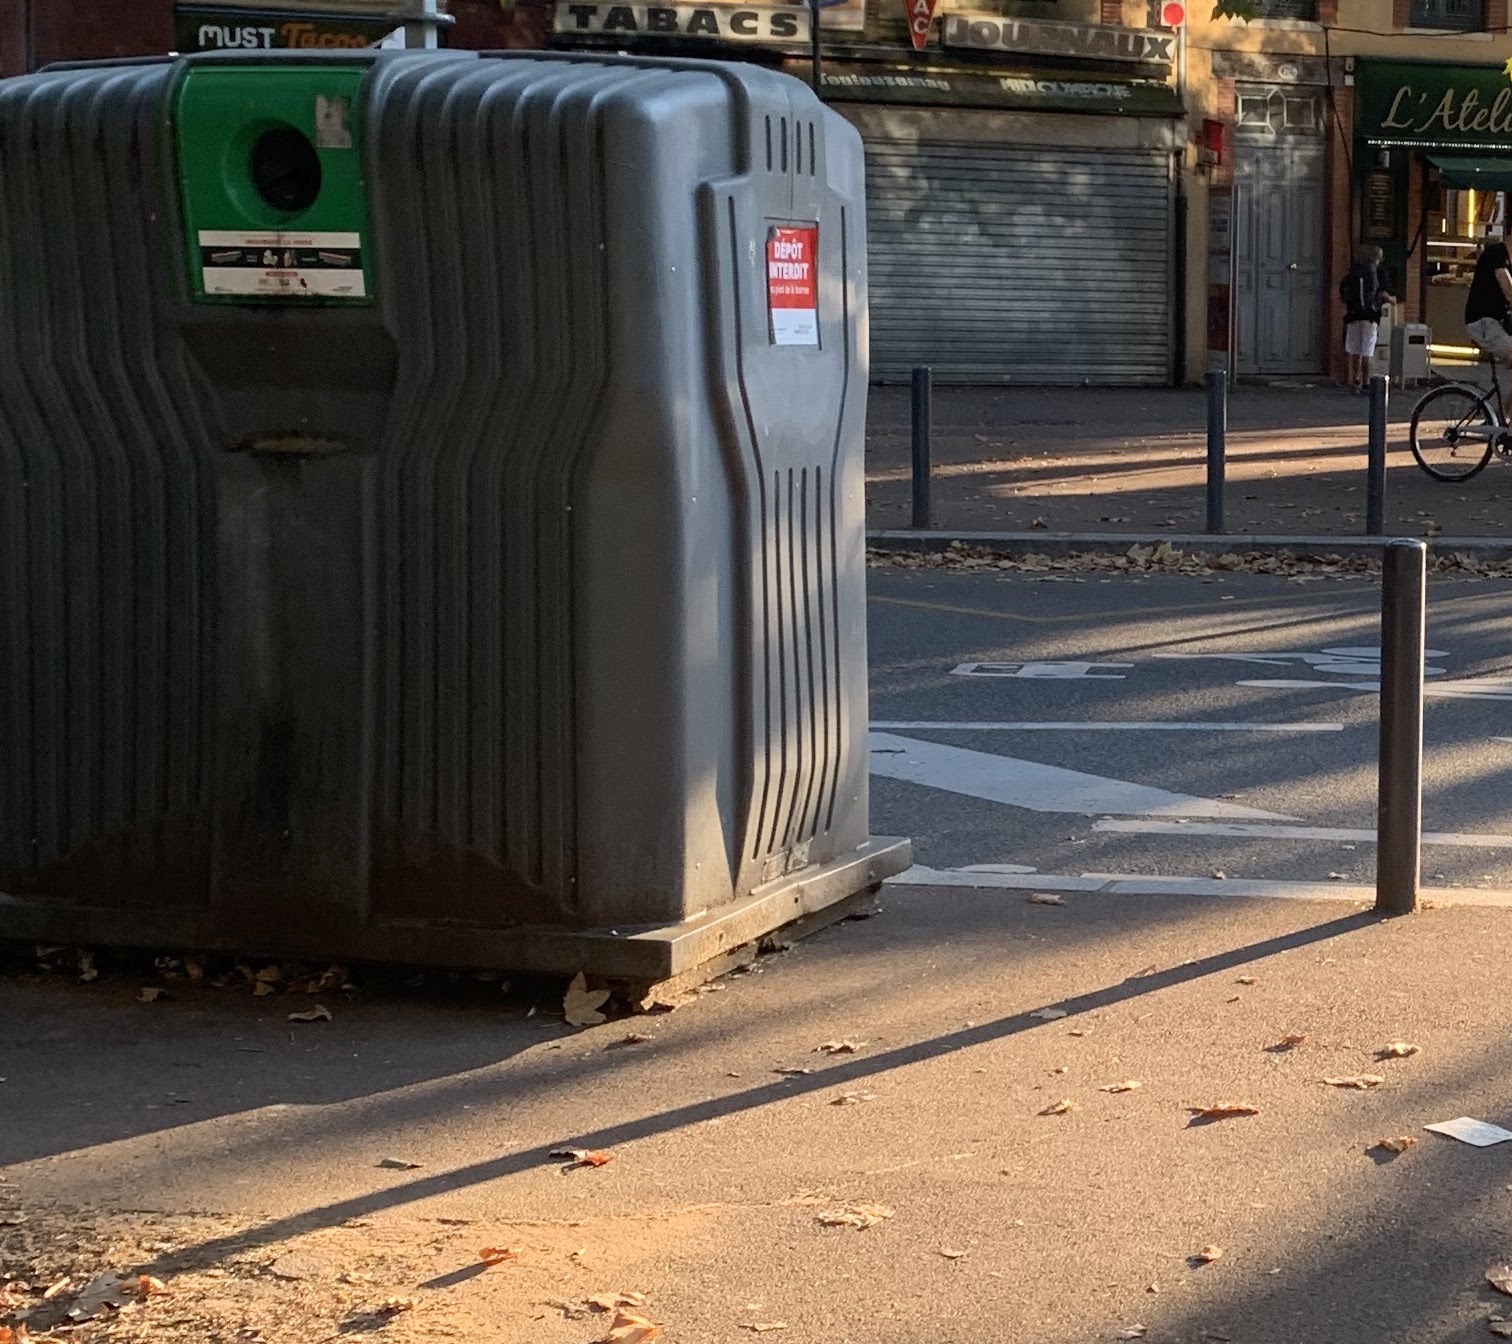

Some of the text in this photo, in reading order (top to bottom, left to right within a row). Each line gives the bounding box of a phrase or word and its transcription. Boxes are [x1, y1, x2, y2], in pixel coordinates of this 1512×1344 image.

[568, 3, 799, 38] TABACS
[198, 24, 276, 49] MUST
[945, 17, 1175, 61] JOURNAUX
[773, 237, 804, 260] DÉPÔT
[768, 261, 809, 280] INTERDIT
